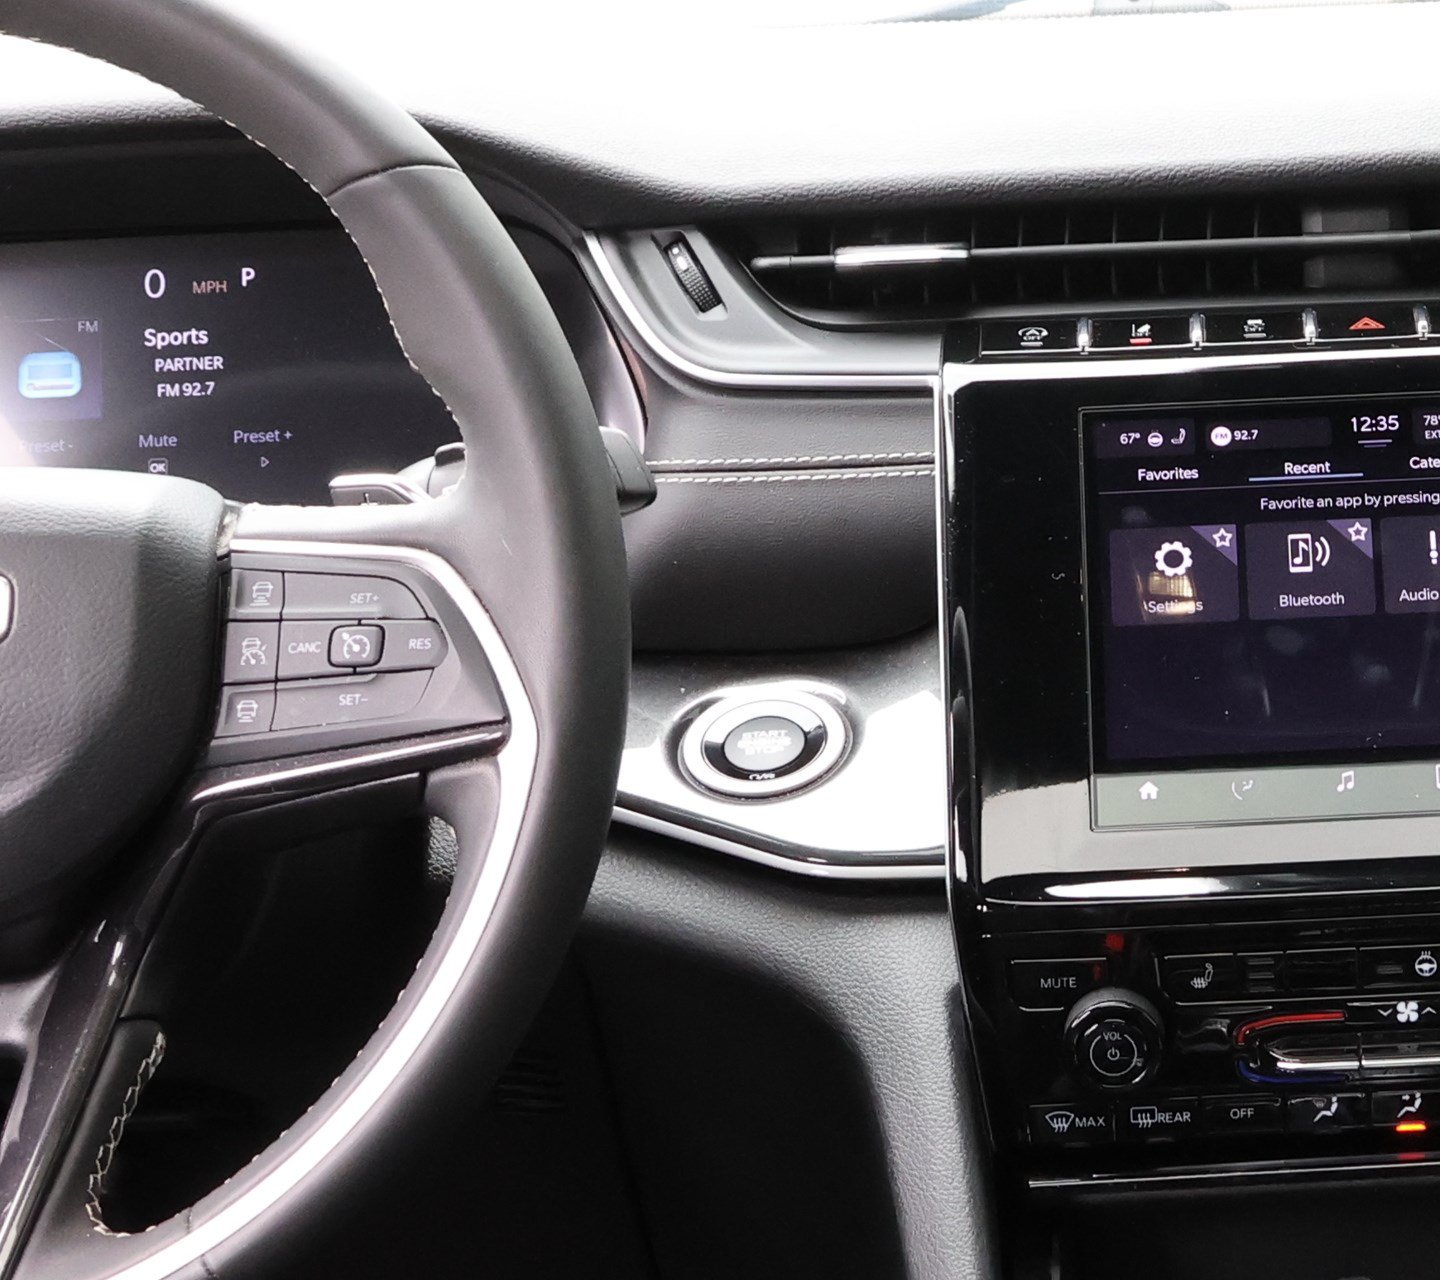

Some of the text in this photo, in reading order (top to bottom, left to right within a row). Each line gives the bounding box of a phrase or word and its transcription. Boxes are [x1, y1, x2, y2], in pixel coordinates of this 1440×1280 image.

[143, 268, 228, 299] 0 MPH
[240, 267, 256, 287] P
[77, 320, 99, 333] FM
[143, 327, 209, 350] Sports
[154, 355, 224, 373] PARTNER
[156, 381, 216, 398] FM 92.7
[1350, 414, 1400, 433] 12:35
[138, 434, 179, 449] Mute
[232, 429, 280, 444] Preset
[1214, 432, 1229, 441] FM
[1233, 428, 1259, 441] 92.7
[149, 462, 167, 473] OK
[1137, 466, 1199, 482] Favorites
[1283, 460, 1331, 475] Recent
[1260, 497, 1315, 511] Favorite
[1316, 498, 1334, 508] an
[1335, 496, 1362, 510] app
[1364, 493, 1381, 507] by
[1383, 490, 1440, 507] pressing
[1279, 591, 1345, 608] Bluetooth
[1399, 588, 1440, 602] Audio
[287, 640, 322, 655] CANC
[408, 637, 432, 650] RES
[1039, 976, 1078, 990] MUTE
[1103, 1031, 1123, 1042] VOL
[1157, 1111, 1191, 1124] REAR
[1229, 1108, 1255, 1120] OFF
[1074, 1116, 1106, 1128] MAX
